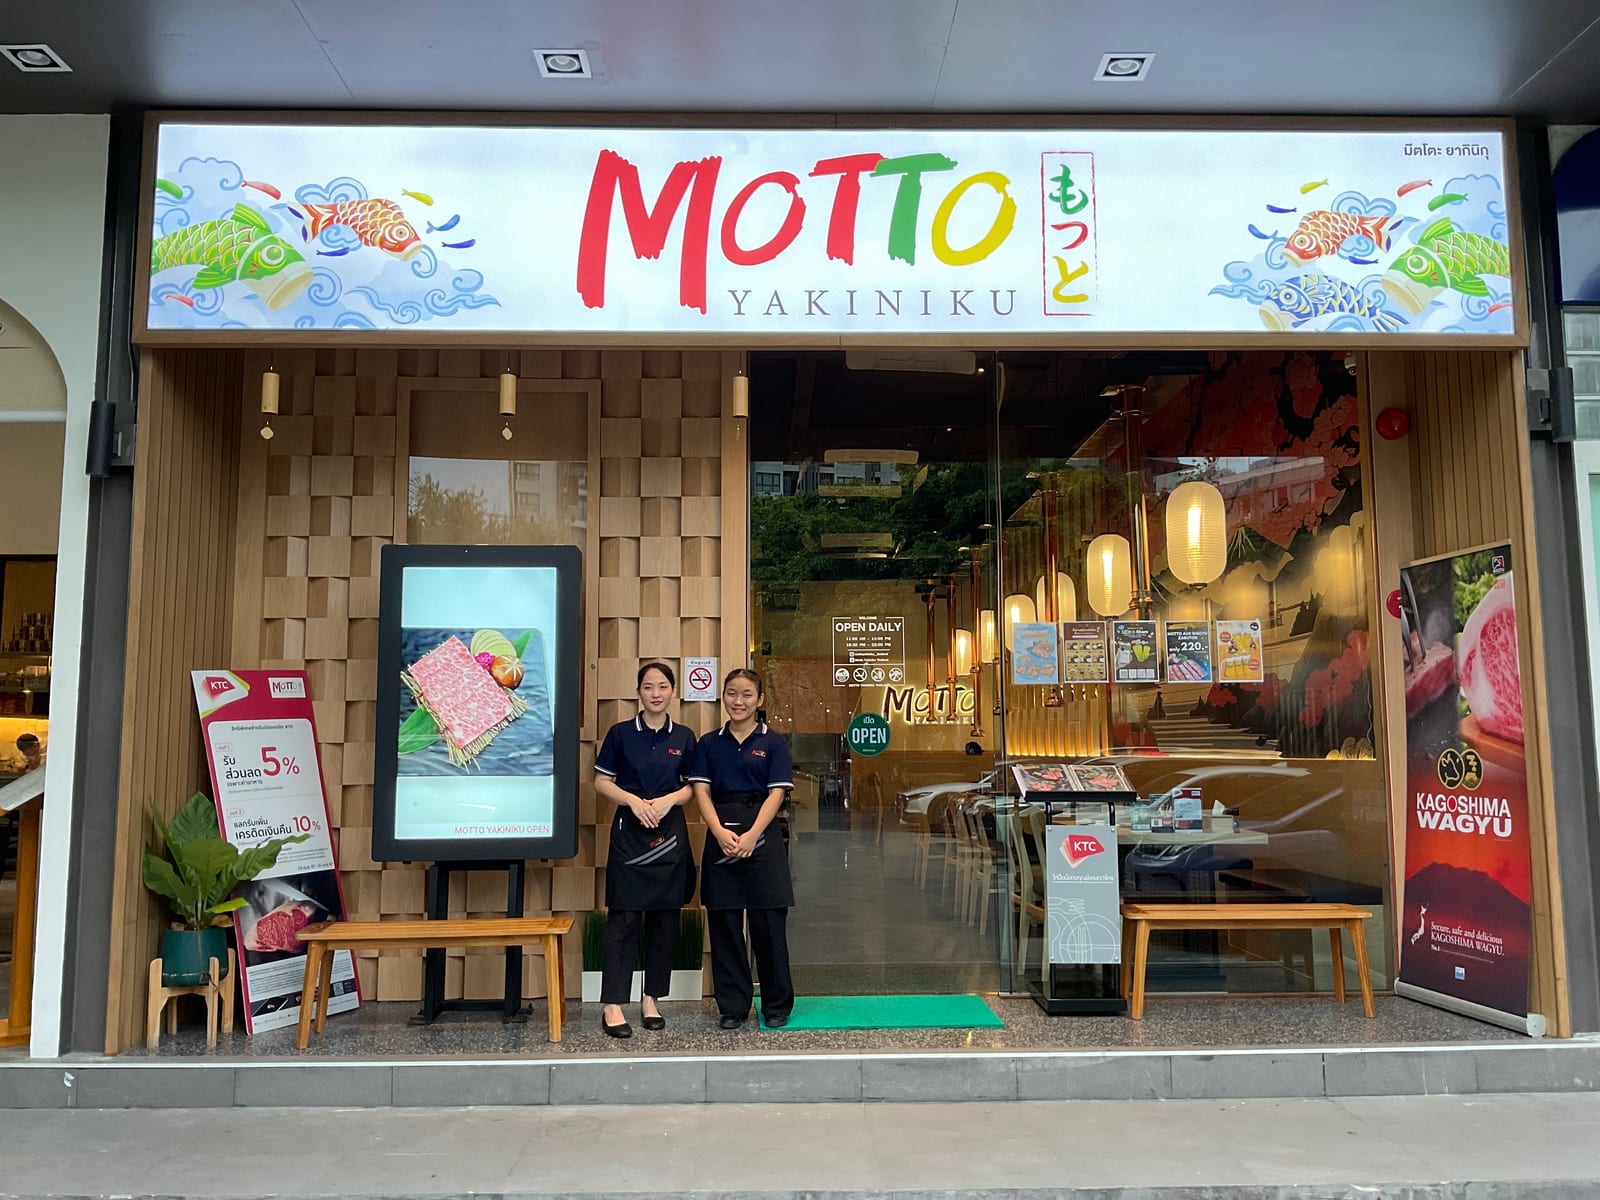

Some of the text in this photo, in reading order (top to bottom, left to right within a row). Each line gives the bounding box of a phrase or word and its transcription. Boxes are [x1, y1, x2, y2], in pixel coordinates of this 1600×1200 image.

[576, 149, 1016, 315] MOTTO
[728, 290, 1017, 316] YAKINIKU
[835, 622, 902, 632] OPEN DAILY
[210, 680, 229, 690] KTC
[272, 681, 298, 693] MOTTO
[852, 727, 887, 744] OPEN
[223, 755, 236, 766] รับ
[225, 767, 262, 780] ส่วนลด
[1416, 792, 1511, 817] KAGOSHIMA
[235, 823, 292, 840] เครดิตเงินคืน
[455, 825, 550, 834] MOTTO YAKINIKU OPEN
[1416, 811, 1512, 838] WAGYU
[1073, 840, 1097, 852] KTC
[1431, 921, 1503, 944] Secure, safe and delicious
[1431, 931, 1474, 949] KAGOSHIMA
